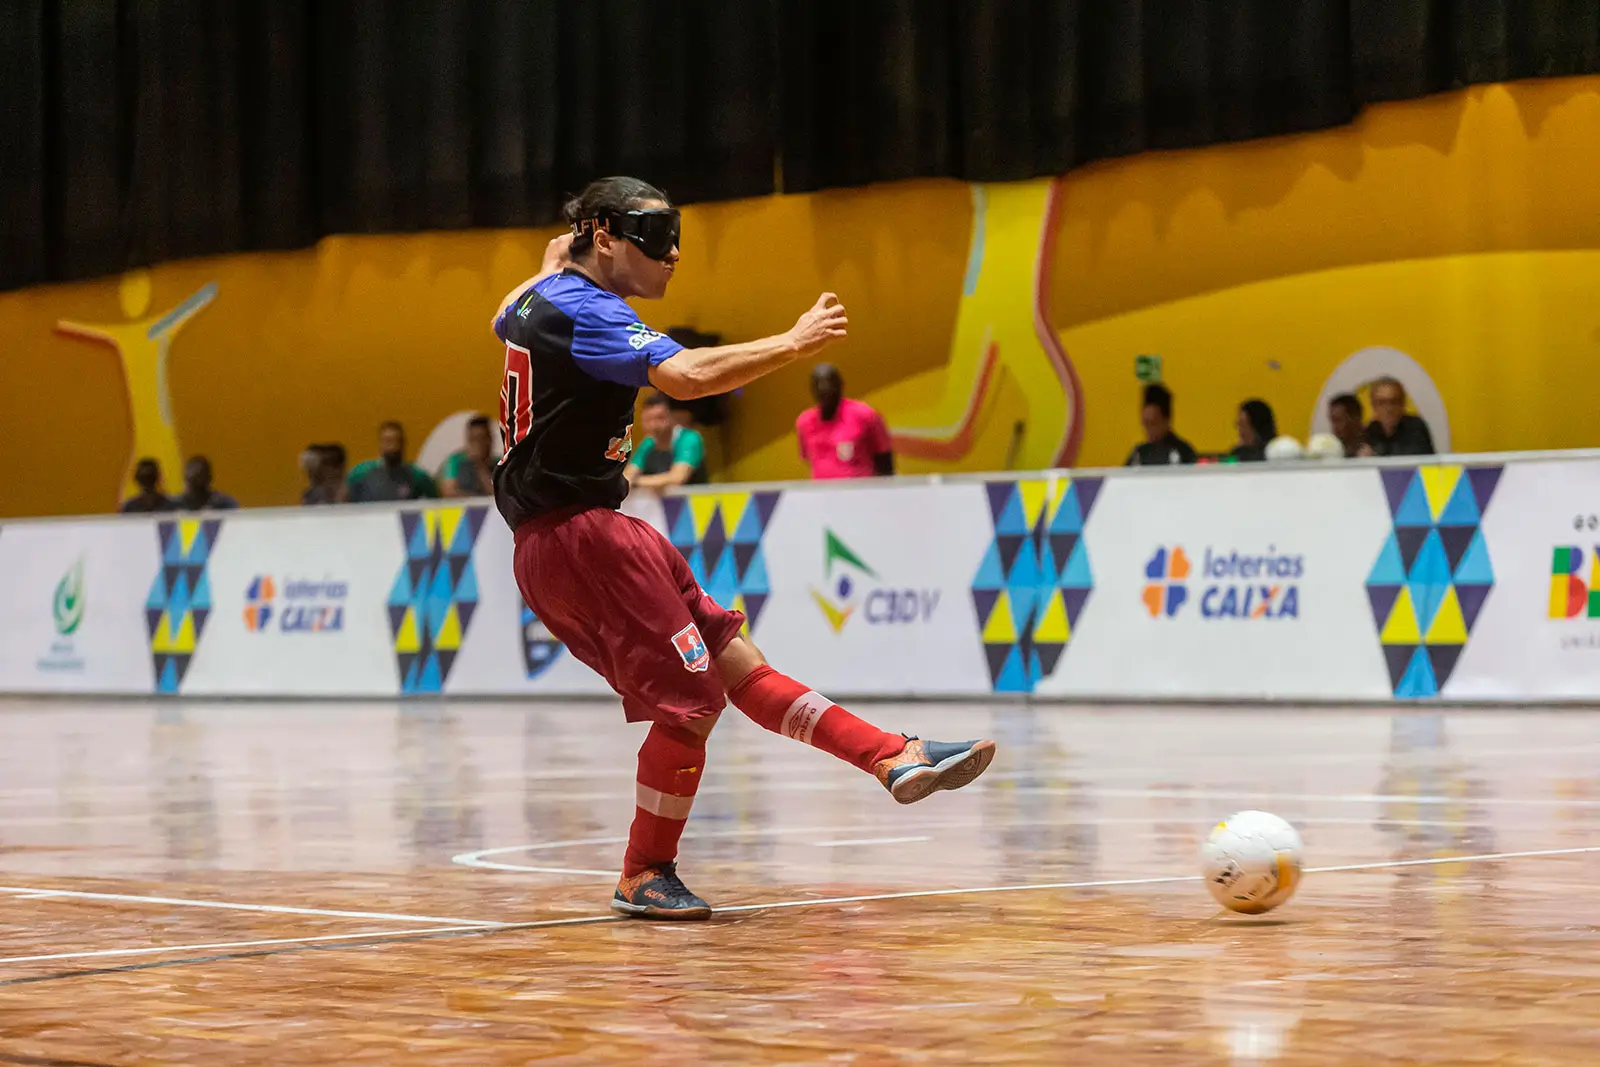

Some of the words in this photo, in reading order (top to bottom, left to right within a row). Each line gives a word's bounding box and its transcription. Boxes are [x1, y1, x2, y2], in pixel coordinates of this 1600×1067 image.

[1203, 543, 1304, 579] loterias
[278, 604, 346, 633] CAIXA
[1200, 583, 1299, 620] CAIXA
